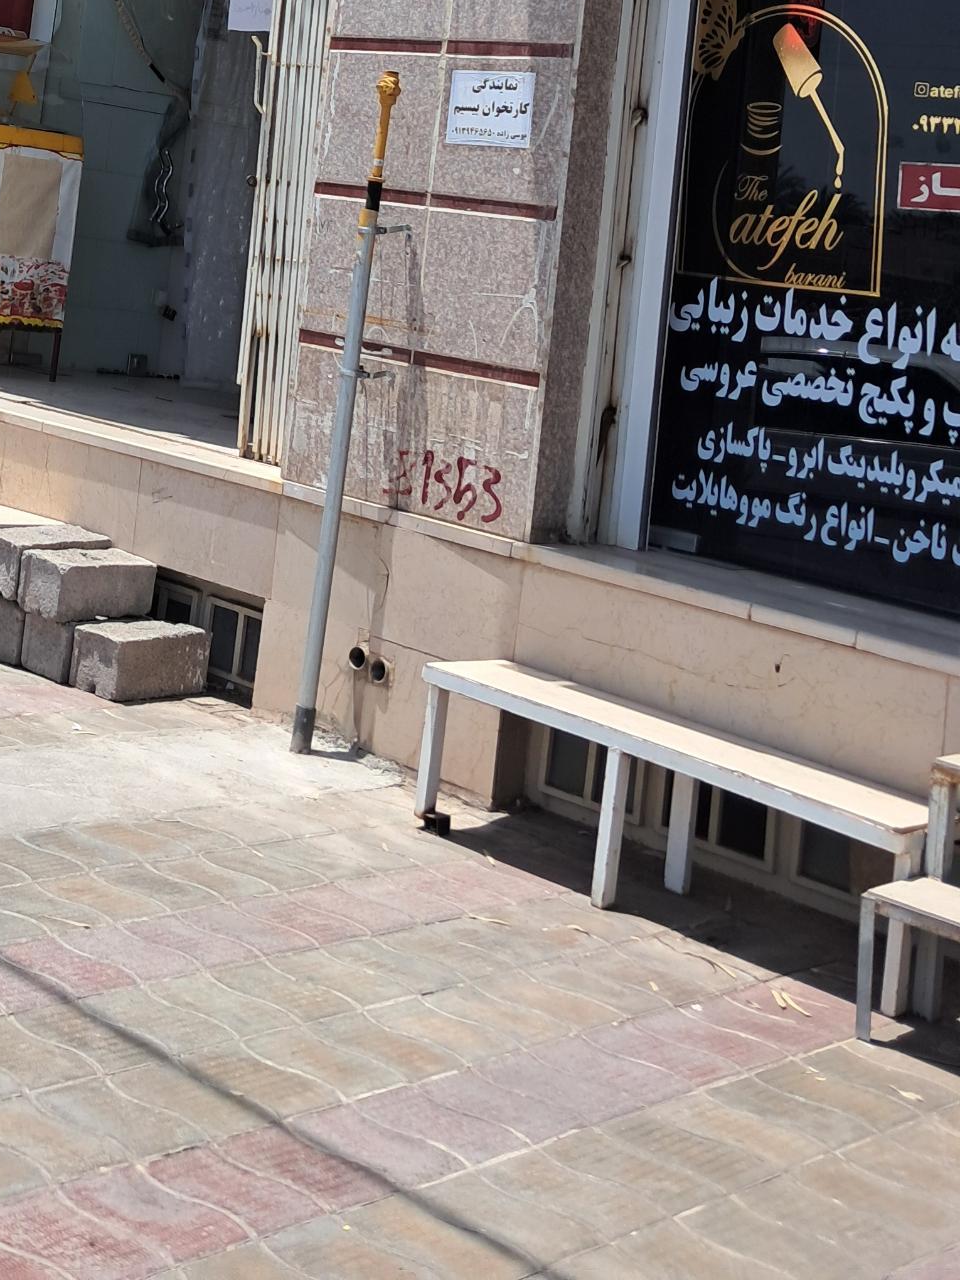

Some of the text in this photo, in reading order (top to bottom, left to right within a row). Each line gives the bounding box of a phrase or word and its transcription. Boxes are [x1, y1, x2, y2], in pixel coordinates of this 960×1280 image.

[734, 175, 768, 202] The
[729, 189, 844, 271] atefeh
[784, 262, 848, 288] barani
[670, 276, 749, 342] زیبایی
[755, 287, 854, 341] خدمات
[857, 301, 936, 369] انواع
[680, 360, 758, 400] عروسی
[762, 368, 856, 407] تخصصی
[858, 375, 915, 434] پکیج
